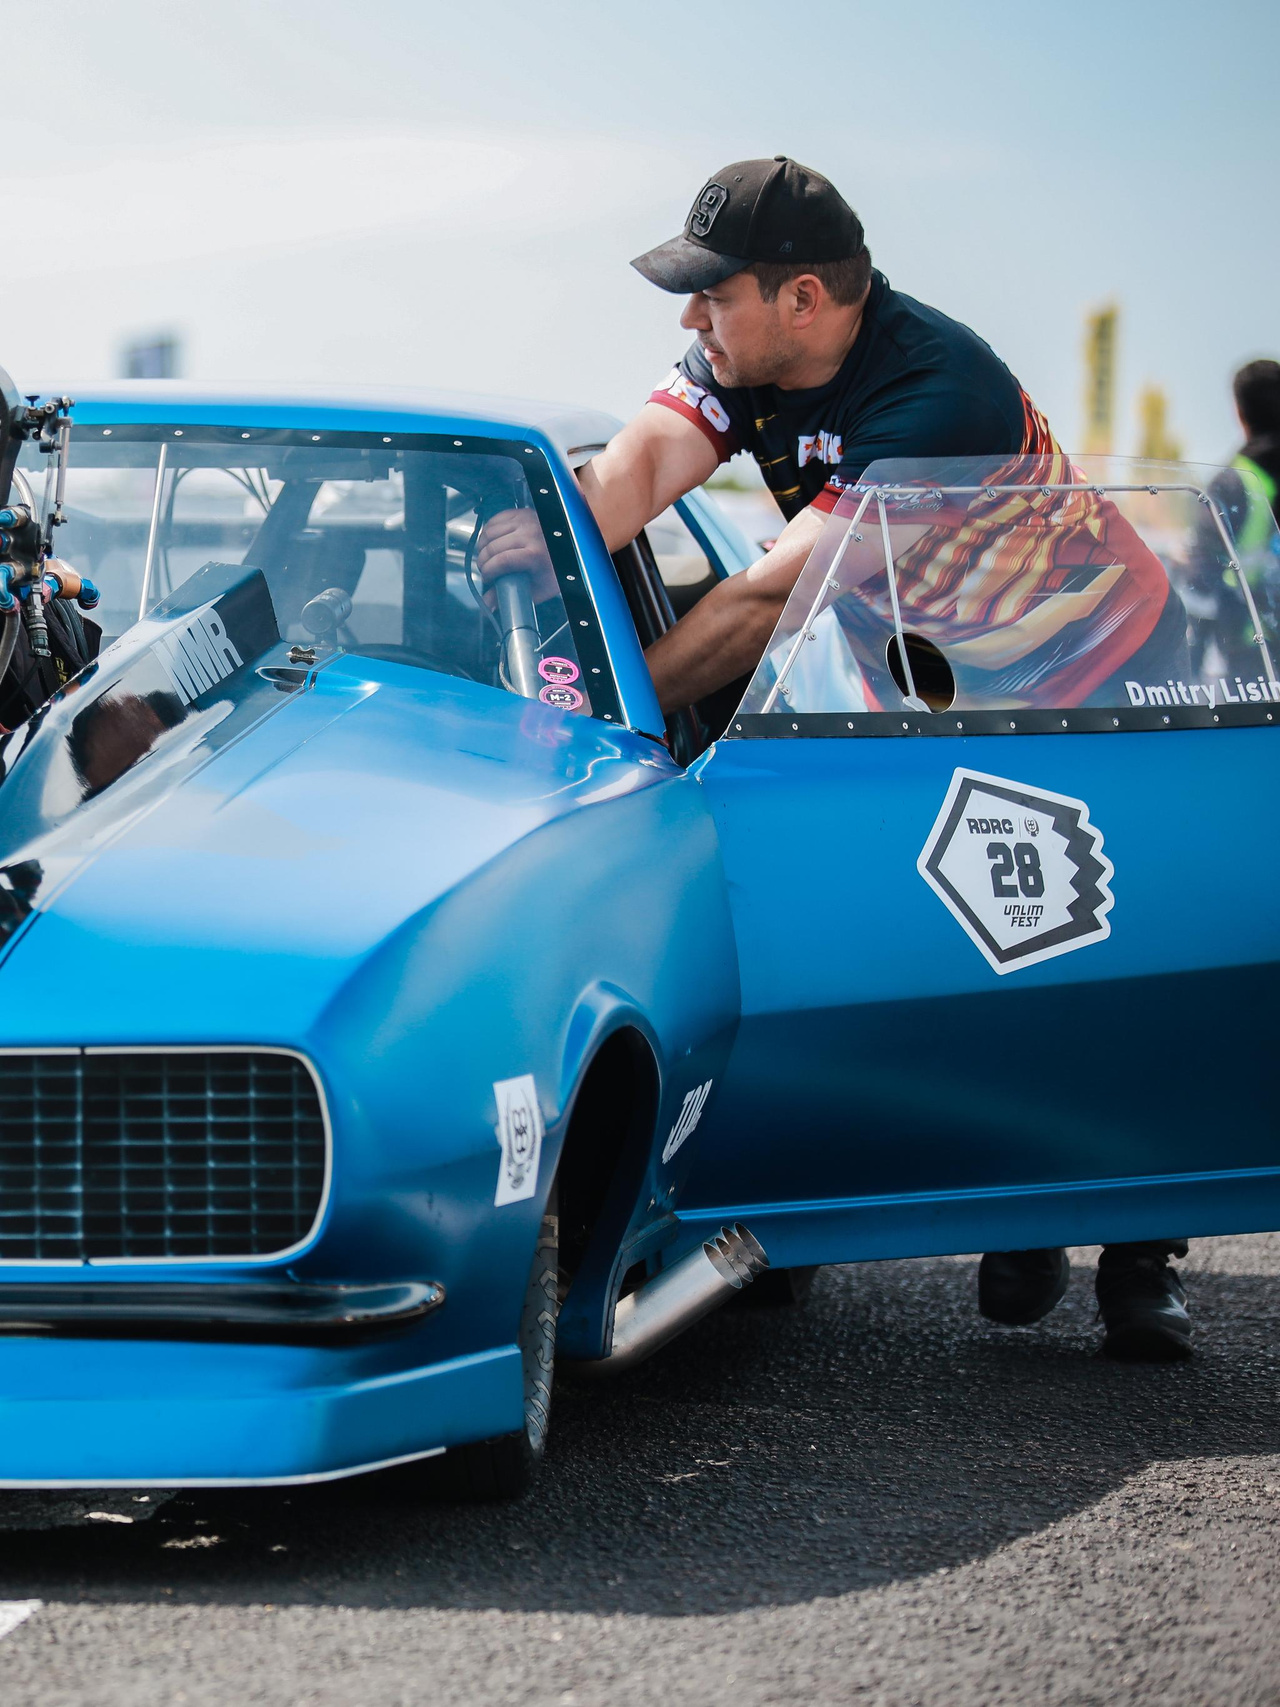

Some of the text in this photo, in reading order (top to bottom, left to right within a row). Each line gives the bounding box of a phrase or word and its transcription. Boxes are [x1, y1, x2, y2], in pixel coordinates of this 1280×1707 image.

[150, 600, 245, 707] MMR
[1124, 680, 1216, 709] Dmitry
[966, 818, 1014, 834] RDRC
[986, 842, 1045, 897] 28
[1011, 917, 1040, 927] FEST
